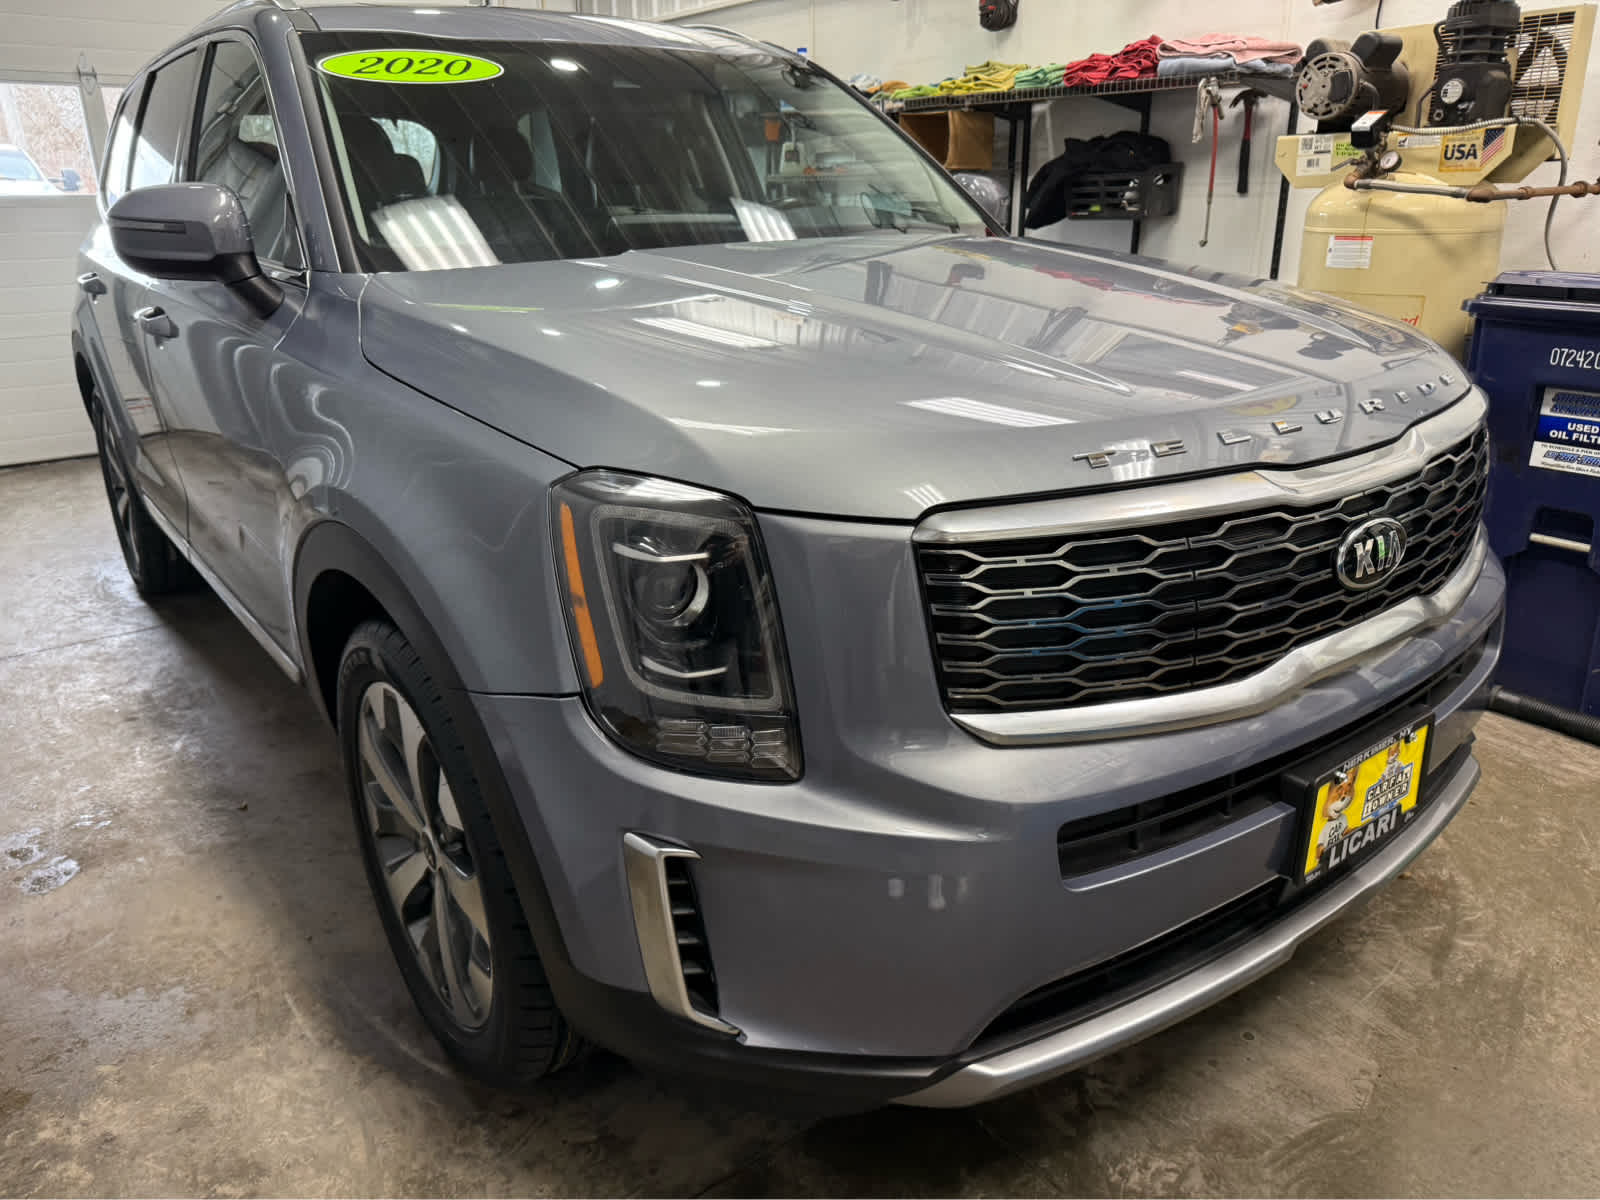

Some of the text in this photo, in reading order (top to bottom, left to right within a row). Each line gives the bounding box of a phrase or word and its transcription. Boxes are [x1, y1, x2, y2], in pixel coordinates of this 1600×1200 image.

[352, 56, 473, 76] 2020
[1444, 143, 1478, 161] USA
[1072, 374, 1457, 469] TELLURIDE
[1567, 422, 1600, 434] USED
[1549, 429, 1569, 440] OIL
[1354, 528, 1402, 578] KIA
[1329, 808, 1397, 869] LICARI
